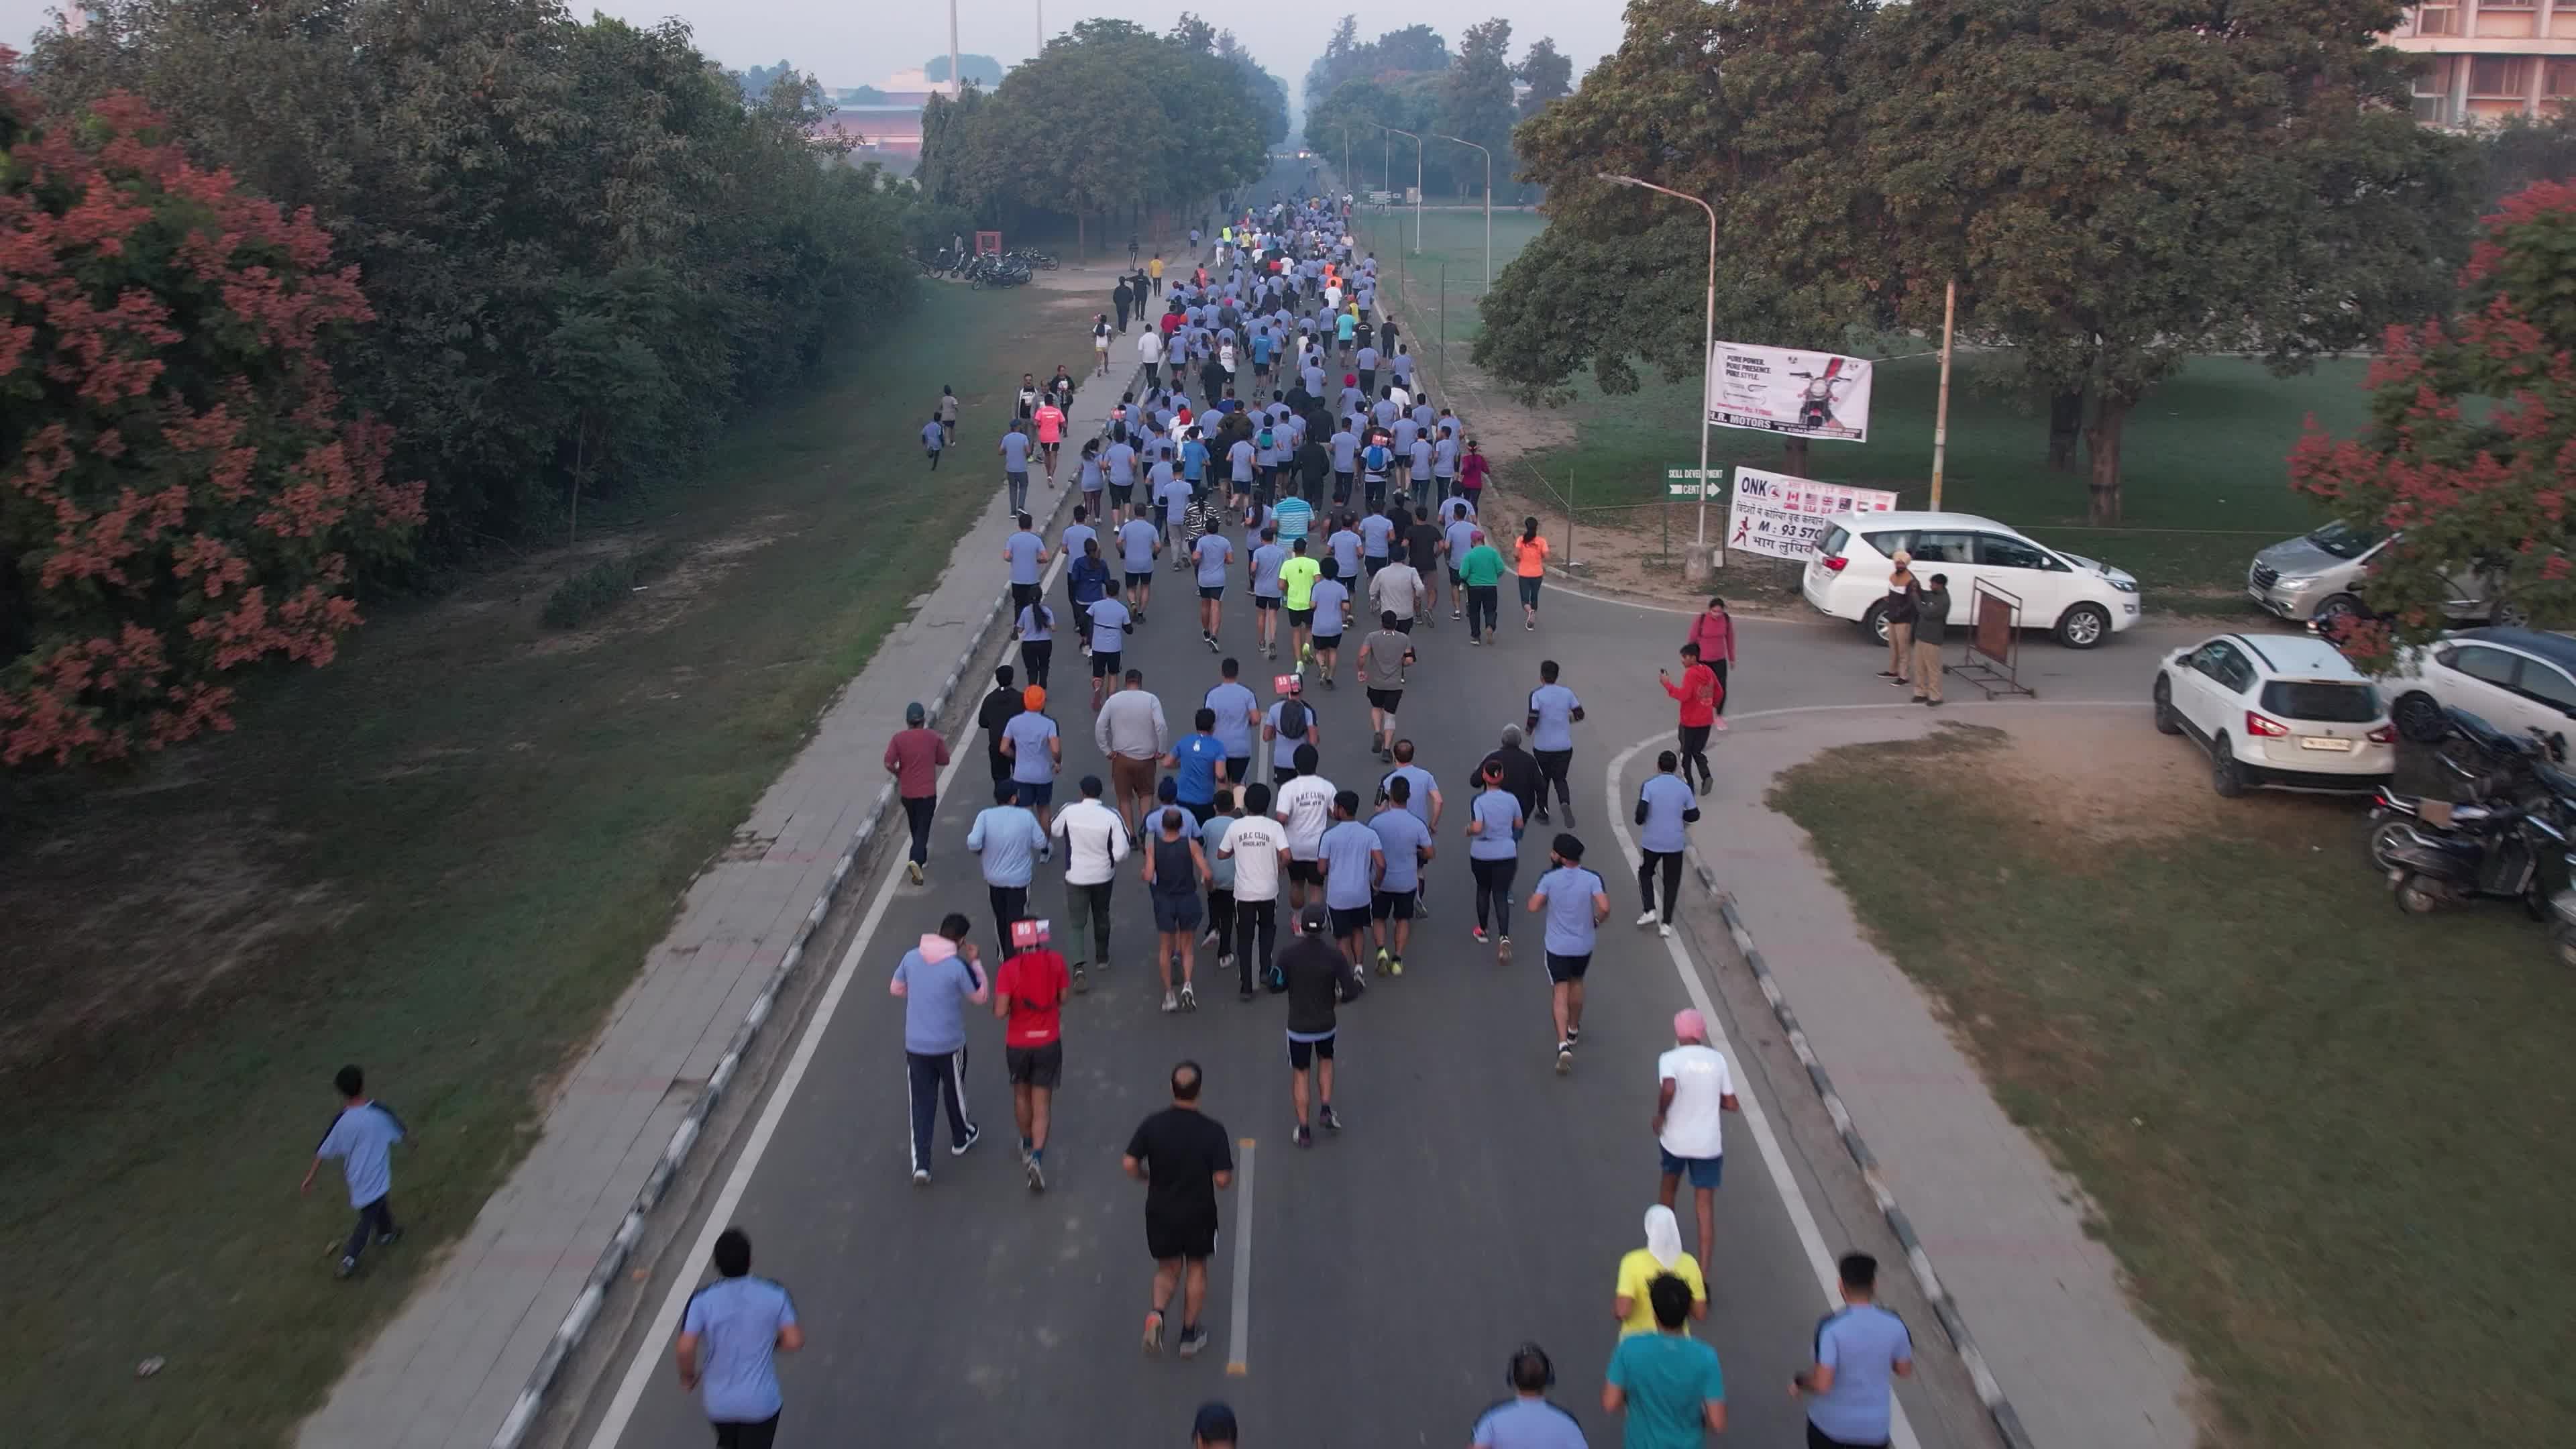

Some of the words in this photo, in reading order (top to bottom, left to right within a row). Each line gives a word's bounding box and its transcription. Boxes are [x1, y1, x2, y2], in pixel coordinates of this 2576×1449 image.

[1727, 355, 1742, 363] PURE
[1726, 362, 1741, 370] PURE
[1729, 415, 1771, 429] MOTORS
[1668, 470, 1683, 478] SKILL
[1683, 484, 1701, 494] CENT
[1741, 476, 1768, 496] ONK
[1781, 525, 1796, 536] 93
